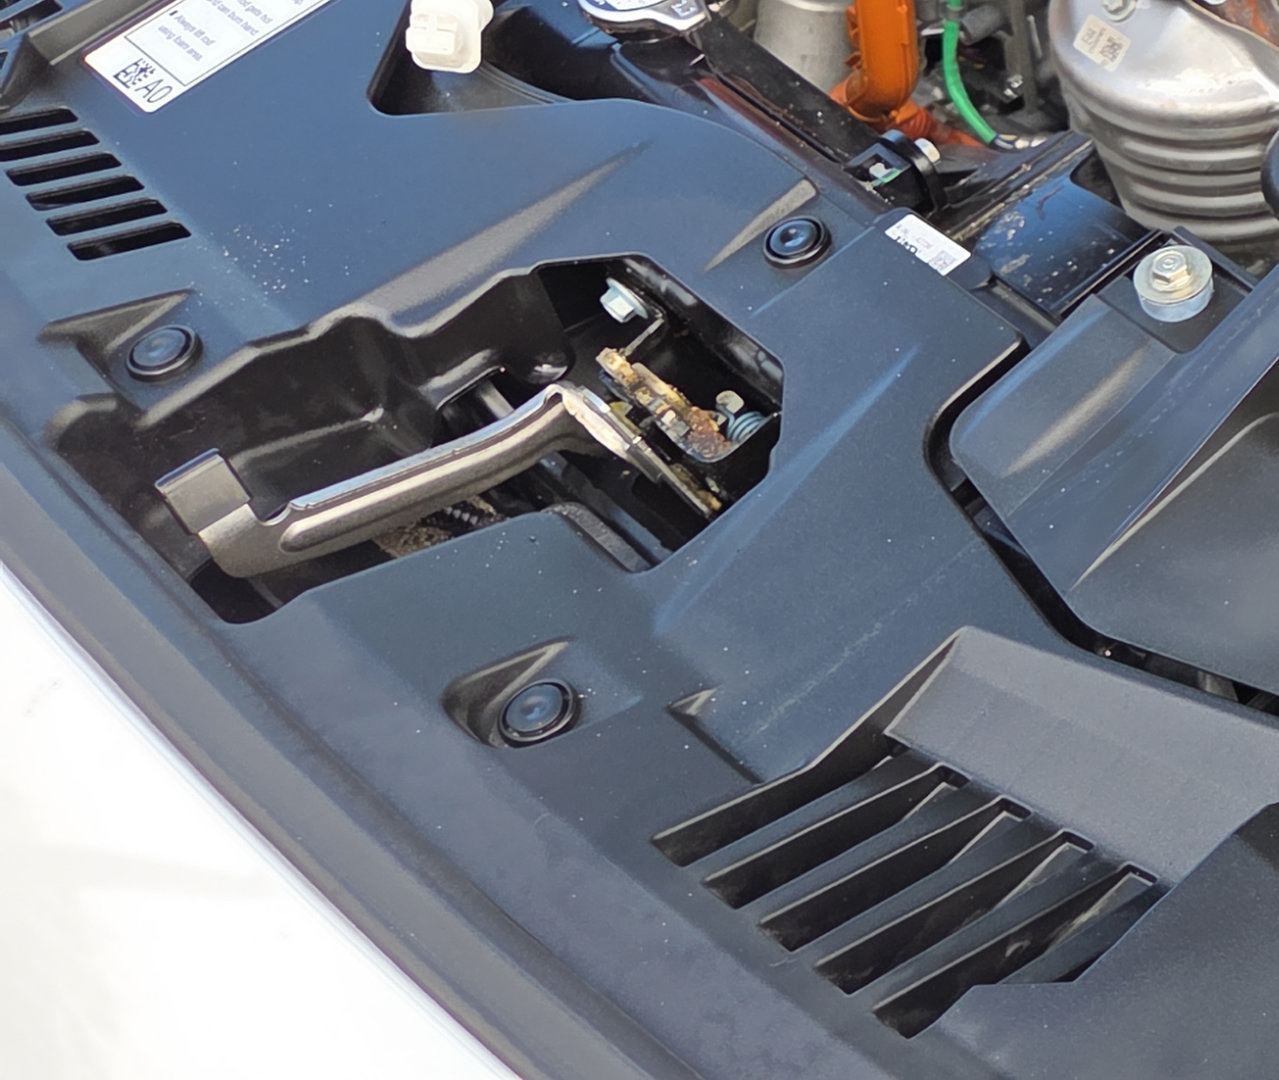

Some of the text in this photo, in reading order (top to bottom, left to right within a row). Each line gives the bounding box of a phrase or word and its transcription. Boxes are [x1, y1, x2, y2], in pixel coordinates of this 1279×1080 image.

[216, 3, 230, 14] can
[245, 4, 262, 17] gets
[173, 14, 196, 33] Always
[156, 24, 176, 39] using
[171, 35, 190, 50] foam
